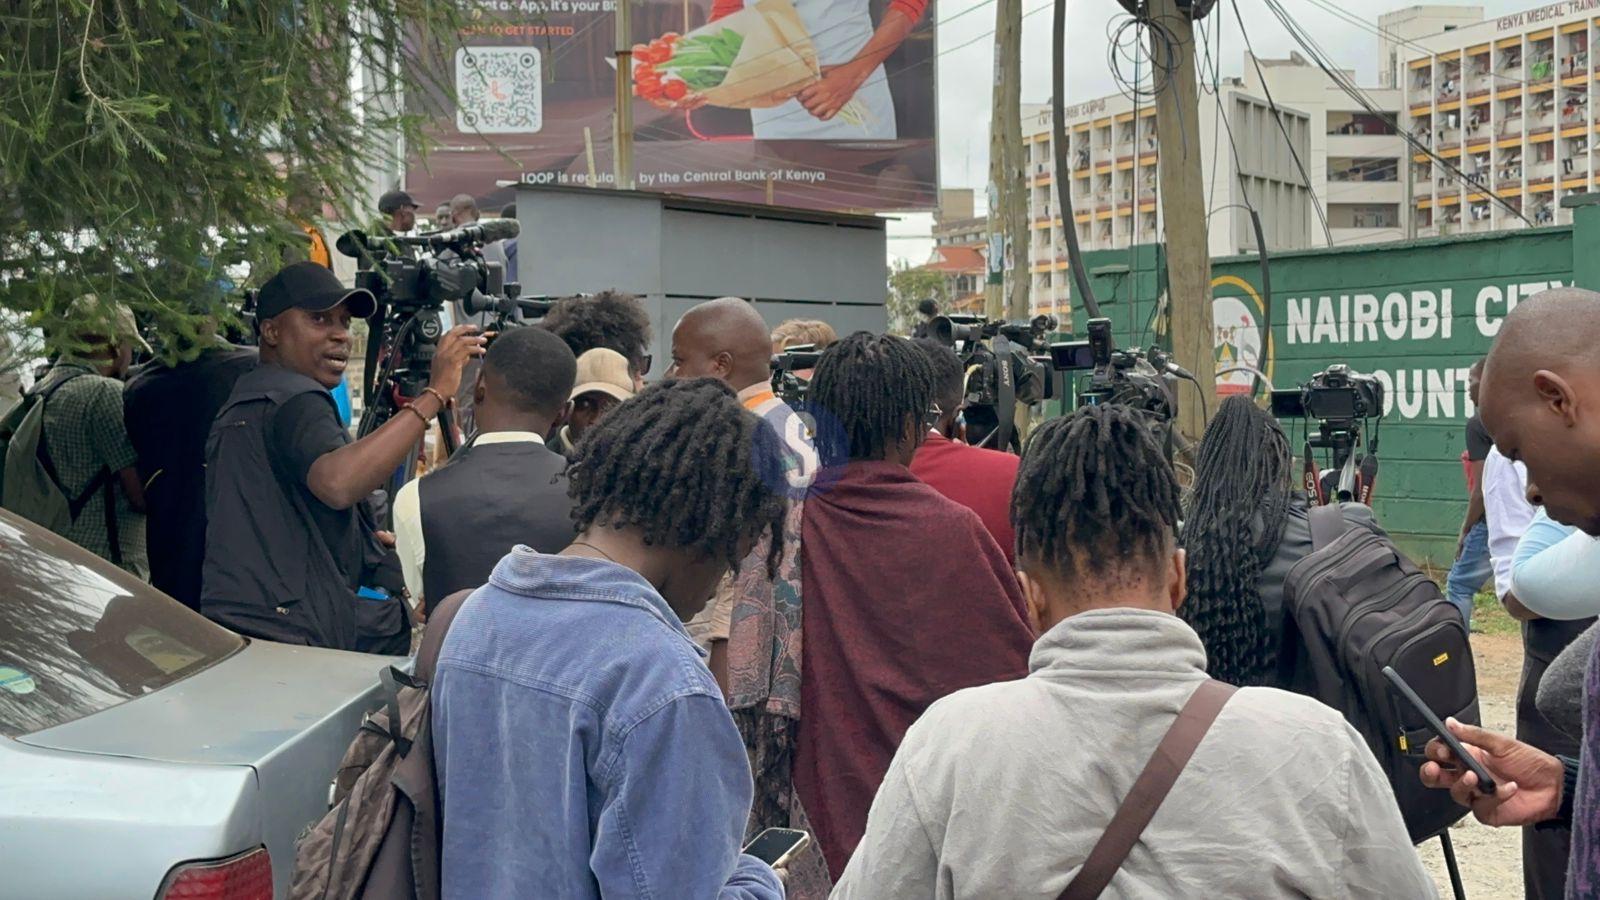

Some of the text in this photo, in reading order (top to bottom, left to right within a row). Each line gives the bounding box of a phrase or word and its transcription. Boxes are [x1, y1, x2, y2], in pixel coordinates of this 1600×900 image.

[550, 0, 569, 11] It's
[570, 1, 600, 14] your
[1496, 14, 1524, 31] KENYA
[1527, 6, 1564, 23] MEDICAL
[505, 25, 525, 36] GET
[527, 25, 575, 36] STARTED
[557, 170, 569, 183] is
[639, 172, 656, 186] by
[658, 172, 680, 183] the
[683, 170, 731, 183] Central
[734, 169, 765, 181] Bank
[766, 169, 782, 181] of
[785, 169, 826, 183] Kenya
[1287, 279, 1575, 345] NAIROBI CI
[1002, 360, 1010, 387] SONY
[1373, 367, 1475, 419] OUNT
[1306, 472, 1317, 498] EOS
